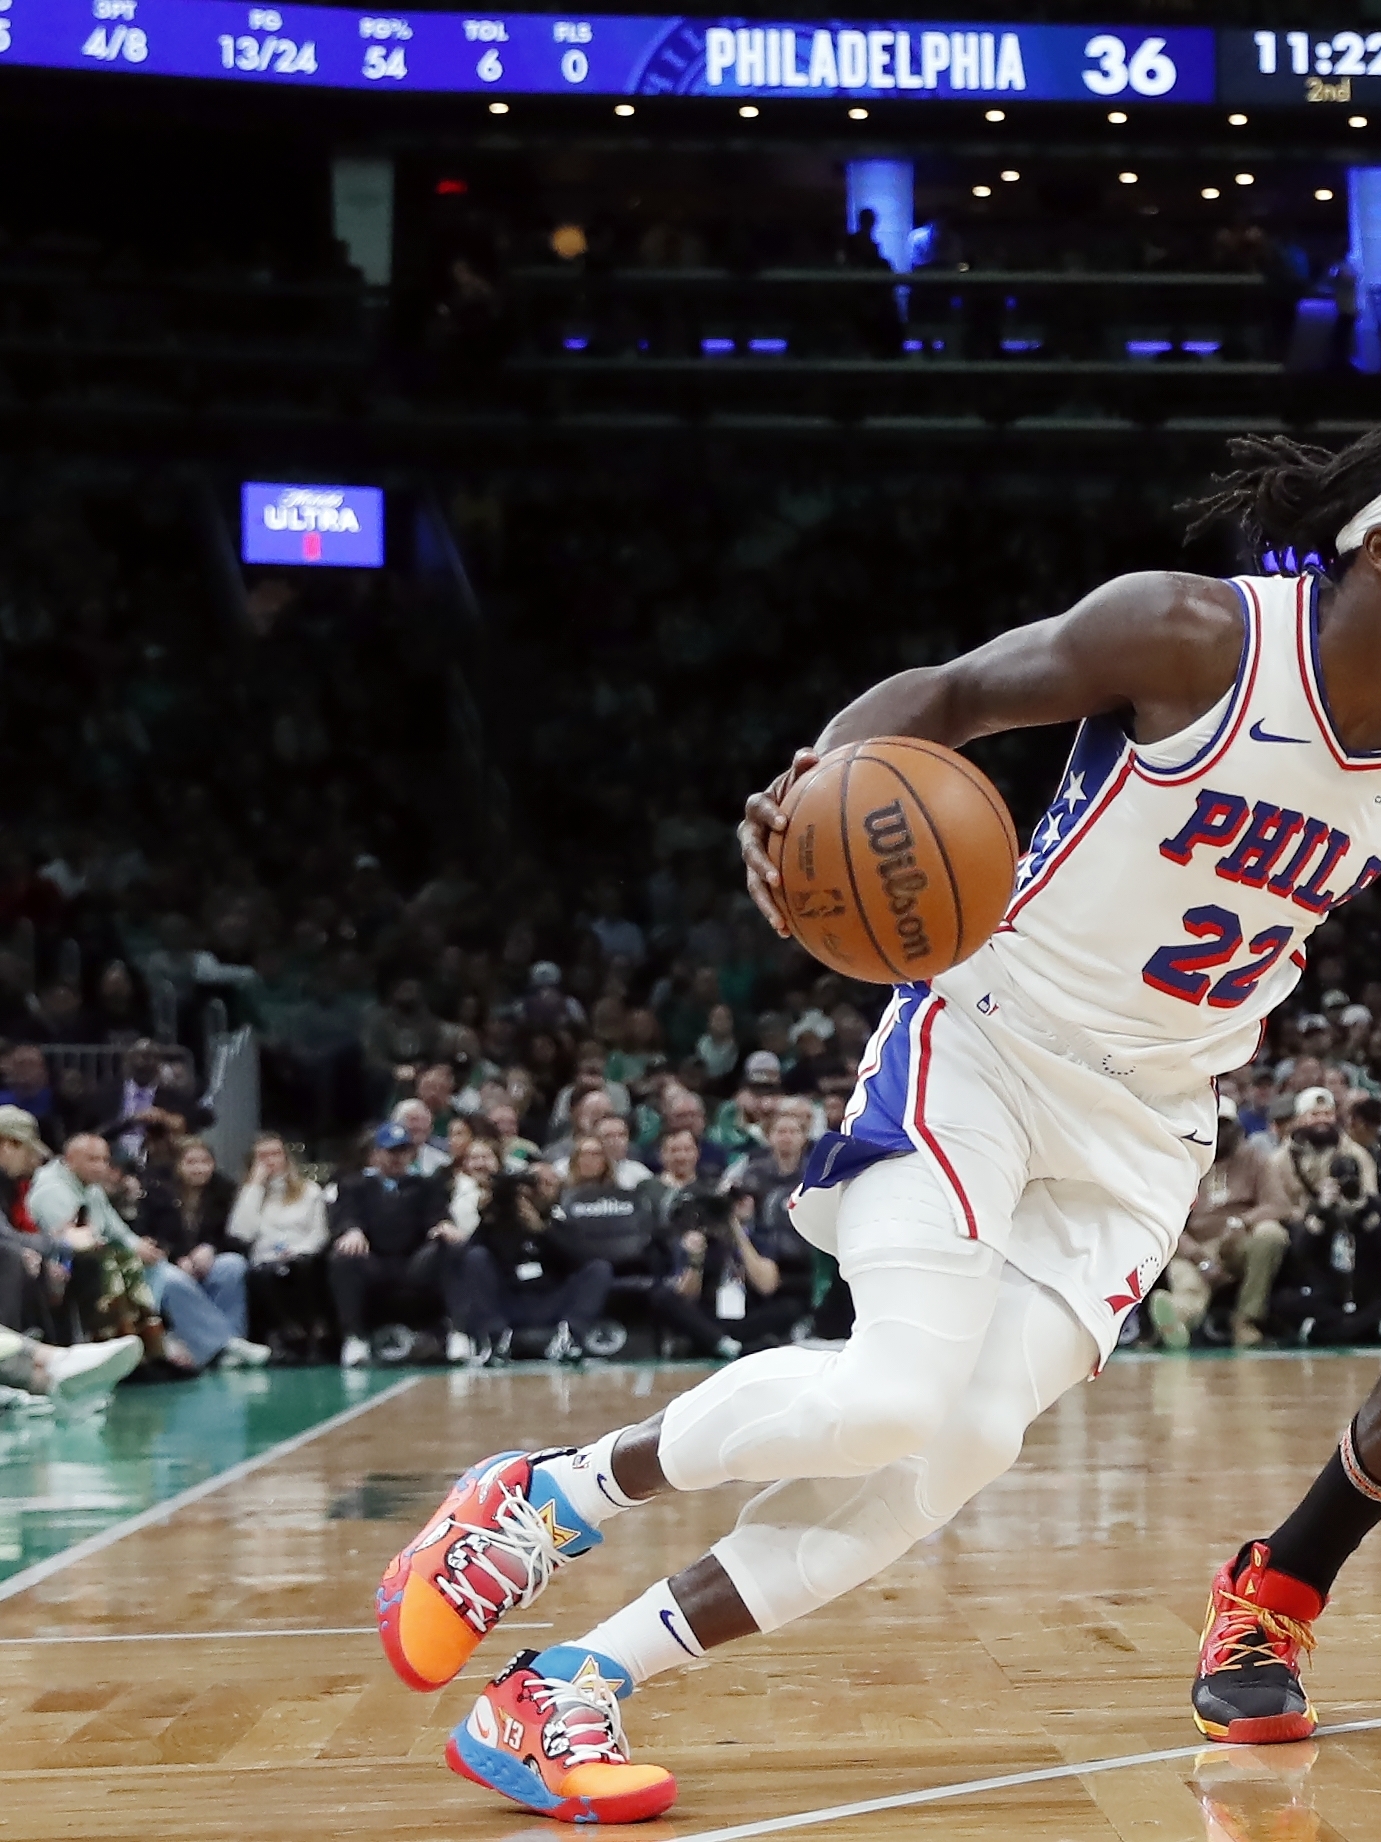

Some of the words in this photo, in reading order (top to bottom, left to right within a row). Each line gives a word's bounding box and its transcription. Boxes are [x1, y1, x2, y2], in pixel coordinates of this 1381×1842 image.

[249, 8, 283, 31] FG
[358, 17, 413, 40] FG%
[463, 19, 509, 42] TOL
[553, 21, 593, 43] FLS
[81, 24, 149, 63] 4/8
[217, 34, 318, 74] 13/24
[361, 45, 408, 80] 54
[476, 48, 503, 82] 6
[561, 49, 589, 83] 0
[706, 27, 1027, 90] PHILADELPHIA
[1082, 35, 1177, 96] 36
[1306, 77, 1351, 102] 2nd
[264, 504, 361, 533] ULTRA
[863, 798, 933, 963] Wilson
[1142, 904, 1294, 1008] 22
[503, 1717, 525, 1752] 13
